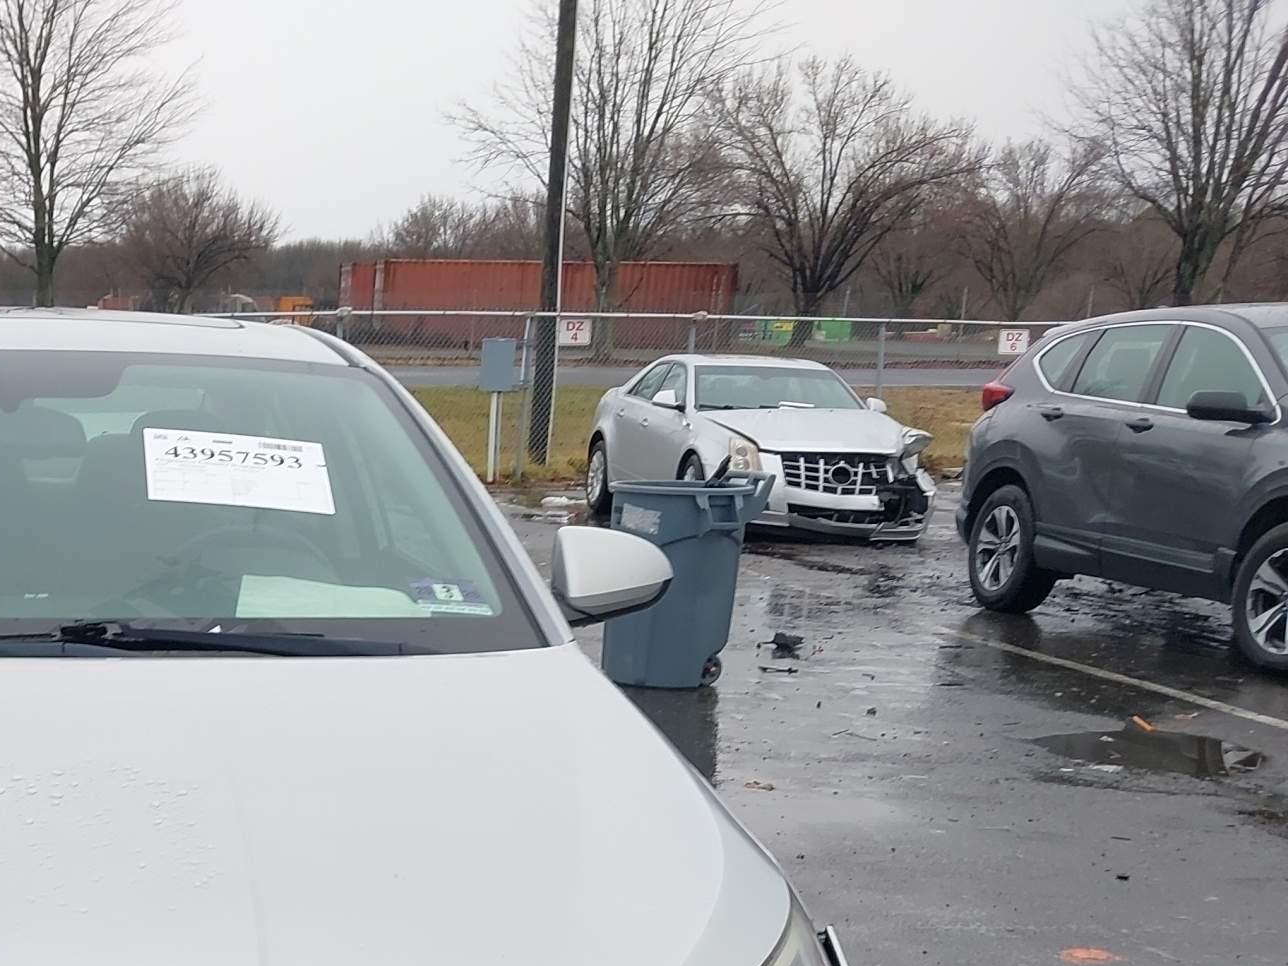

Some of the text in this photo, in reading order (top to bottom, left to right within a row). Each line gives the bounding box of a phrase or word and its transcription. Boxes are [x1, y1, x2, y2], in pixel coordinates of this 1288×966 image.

[566, 321, 585, 332] DZ
[570, 332, 579, 342] 4
[1006, 332, 1023, 342] DZ
[1010, 343, 1017, 352] 6
[165, 445, 303, 470] 43957593
[441, 585, 454, 599] 3
